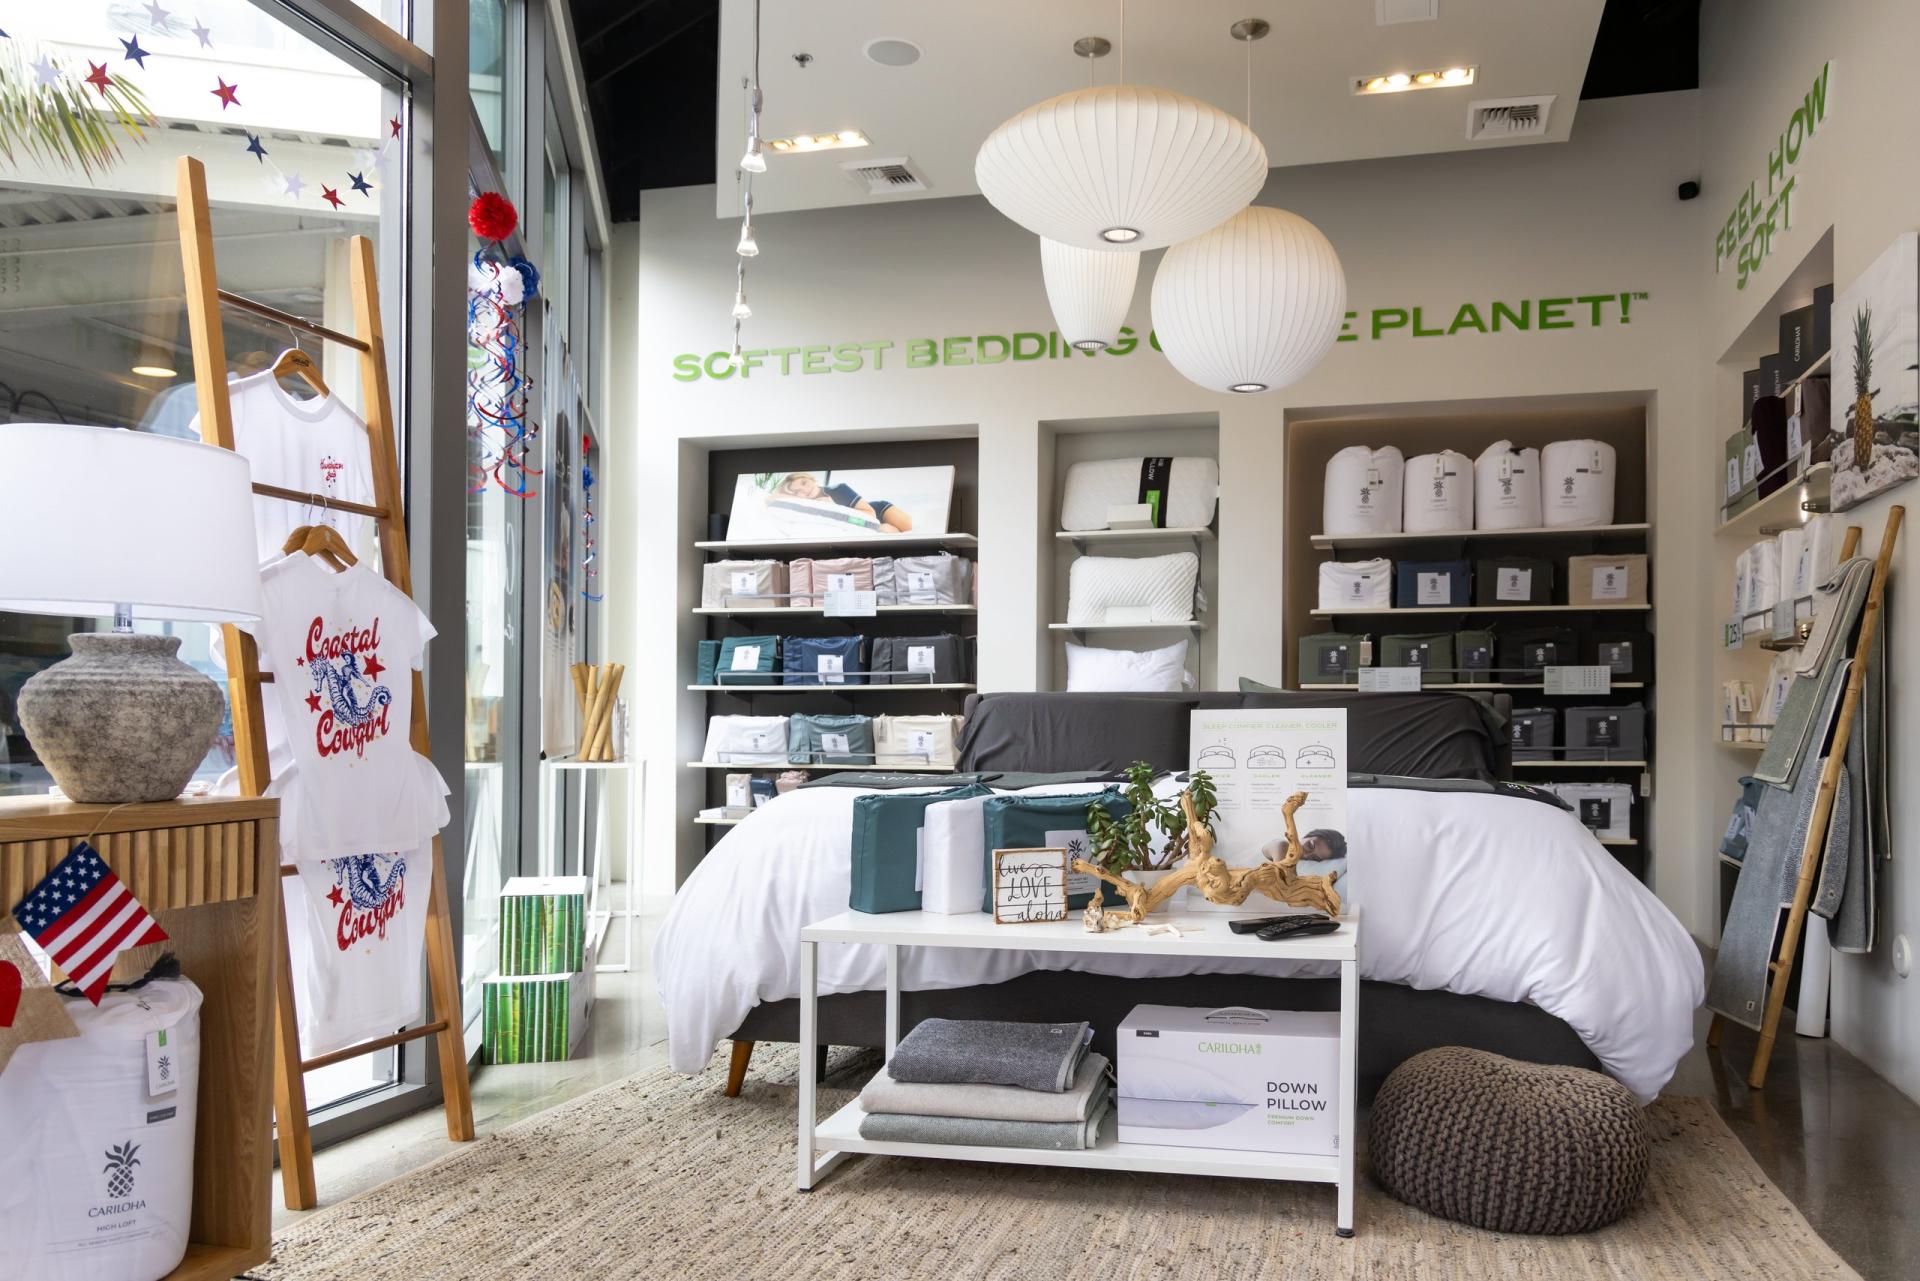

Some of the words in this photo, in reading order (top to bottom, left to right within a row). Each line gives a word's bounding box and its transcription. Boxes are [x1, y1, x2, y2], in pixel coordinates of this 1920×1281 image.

[1716, 180, 1761, 274] FEEL
[1768, 61, 1829, 196] HOW
[1737, 175, 1795, 290] SOFT
[672, 341, 894, 382] SOFTEST
[306, 616, 380, 663] Coastal
[317, 703, 390, 758] Cowgirl
[1008, 875, 1052, 902] LOVE
[337, 874, 405, 951] Cowgirl
[1016, 899, 1067, 922] aloha
[1267, 1081, 1318, 1094] DOWN
[1267, 1098, 1327, 1111] PILLOW
[88, 1199, 146, 1218] CARILOHA
[96, 1223, 117, 1233] HIGH
[118, 1219, 137, 1229] LOFT
